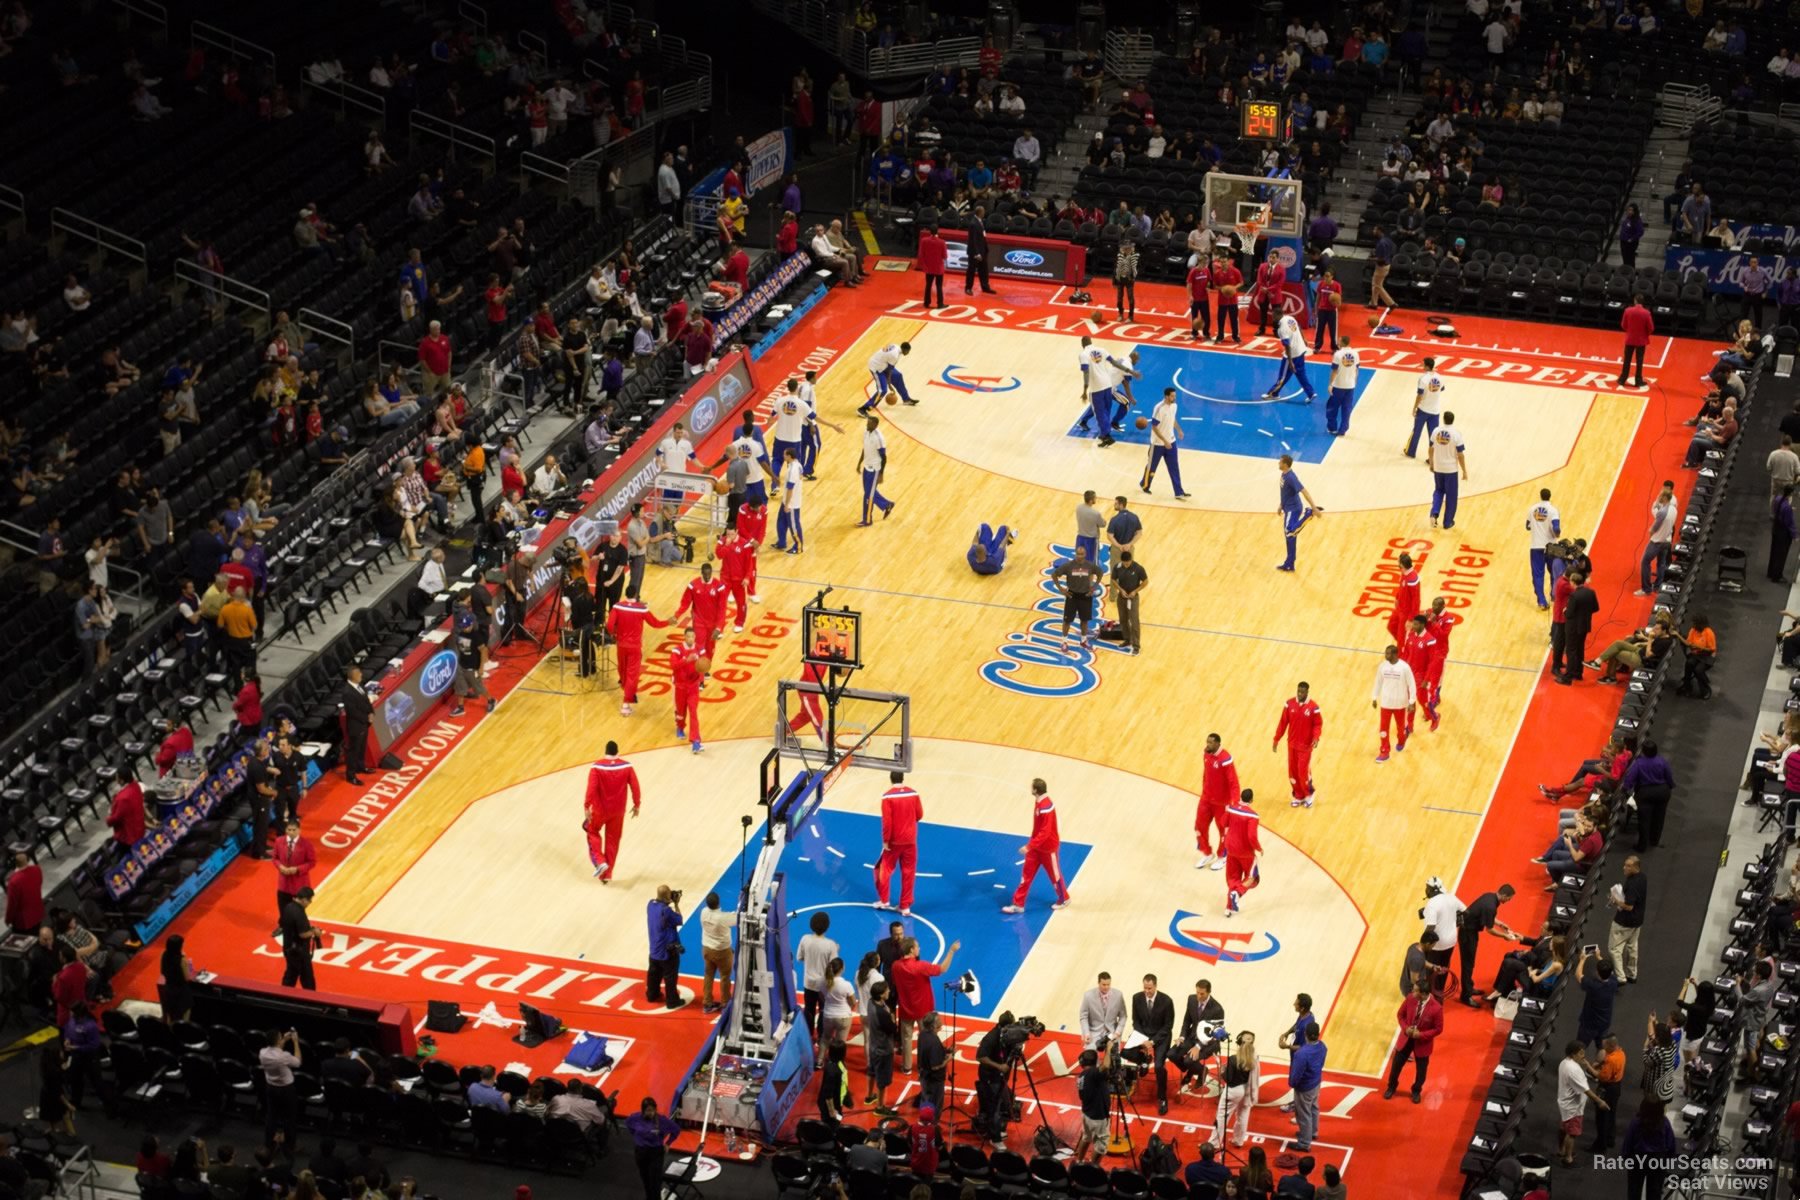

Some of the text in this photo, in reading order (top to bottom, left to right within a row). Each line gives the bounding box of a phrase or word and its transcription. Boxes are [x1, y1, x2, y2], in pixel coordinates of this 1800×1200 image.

[1247, 116, 1274, 136] 24
[1250, 104, 1277, 117] 15:55
[1012, 251, 1036, 265] Ford
[886, 299, 1658, 394] LOS ANGELE CLIPPERS
[695, 404, 717, 431] Ford
[595, 457, 662, 520] TRANSPORTATIO
[425, 660, 454, 694] Ford
[699, 611, 800, 703] Center
[321, 720, 465, 850] CLIPPERS.COM
[254, 932, 695, 1014] CLIPPERS
